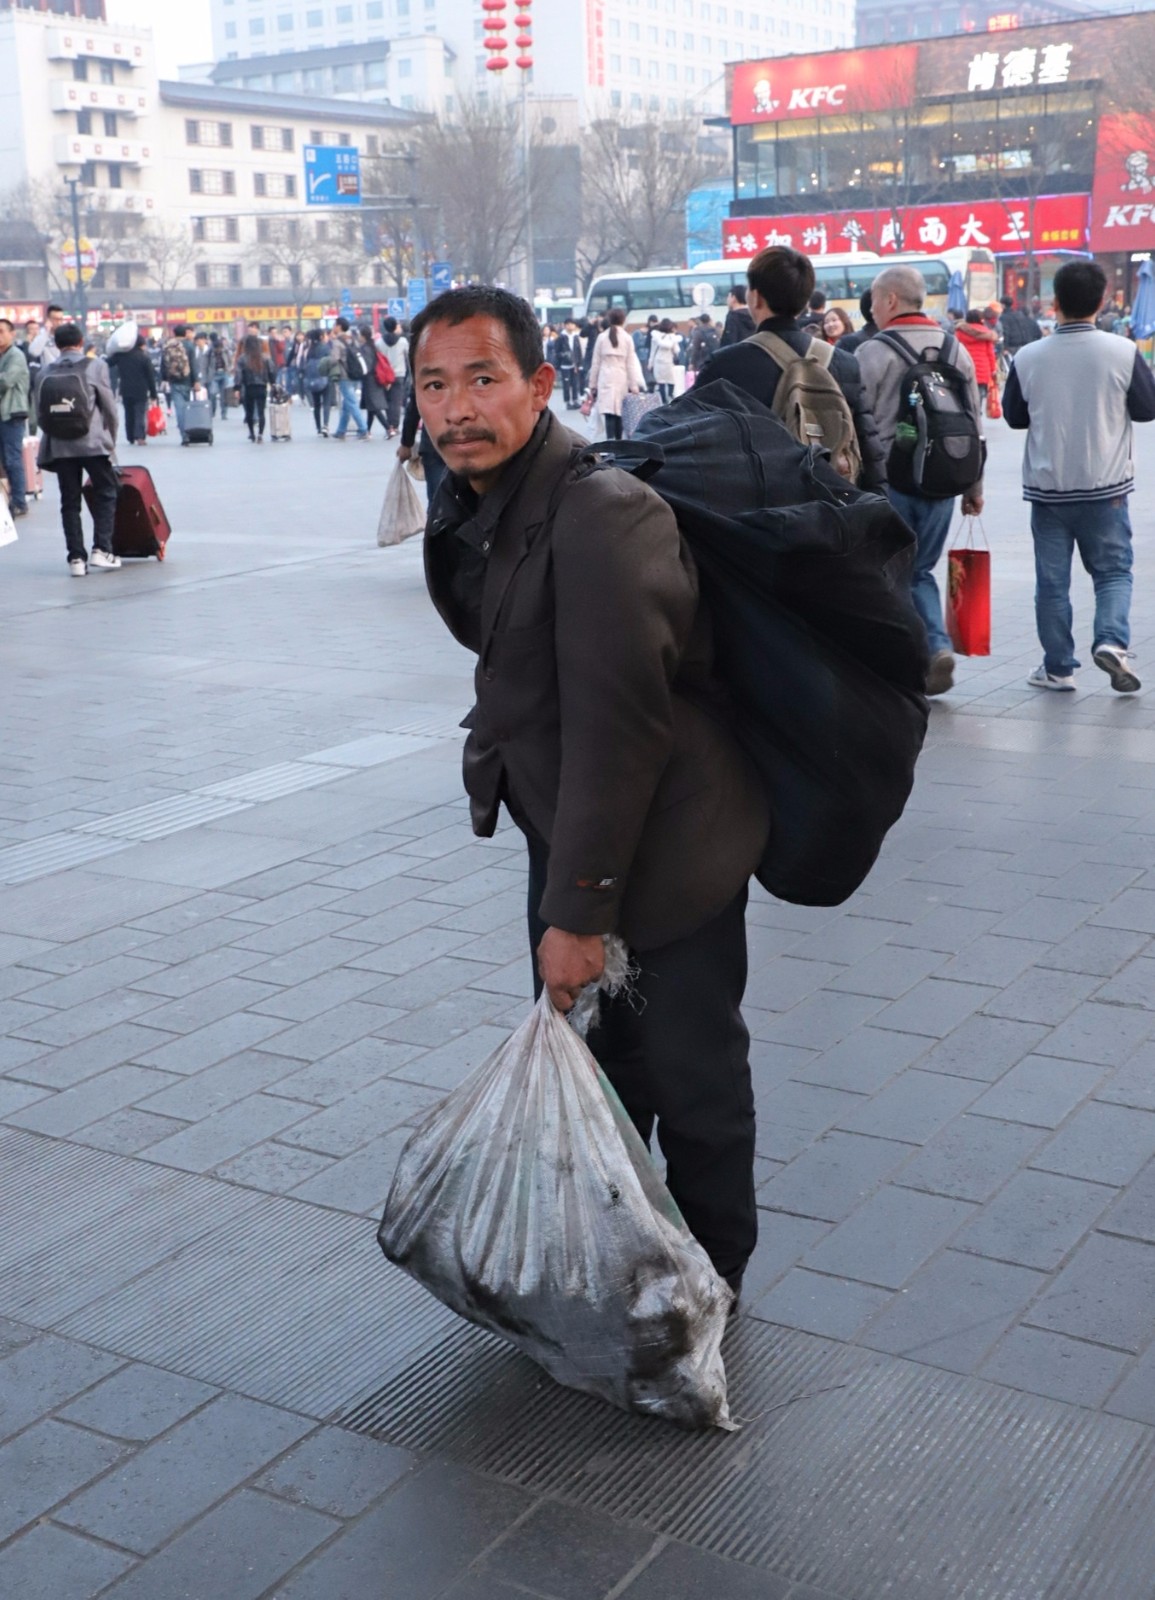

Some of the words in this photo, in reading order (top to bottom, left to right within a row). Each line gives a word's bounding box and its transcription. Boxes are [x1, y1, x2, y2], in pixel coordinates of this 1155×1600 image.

[968, 43, 1073, 91] 肯德基
[787, 84, 847, 110] KFC
[1103, 204, 1155, 228] KF
